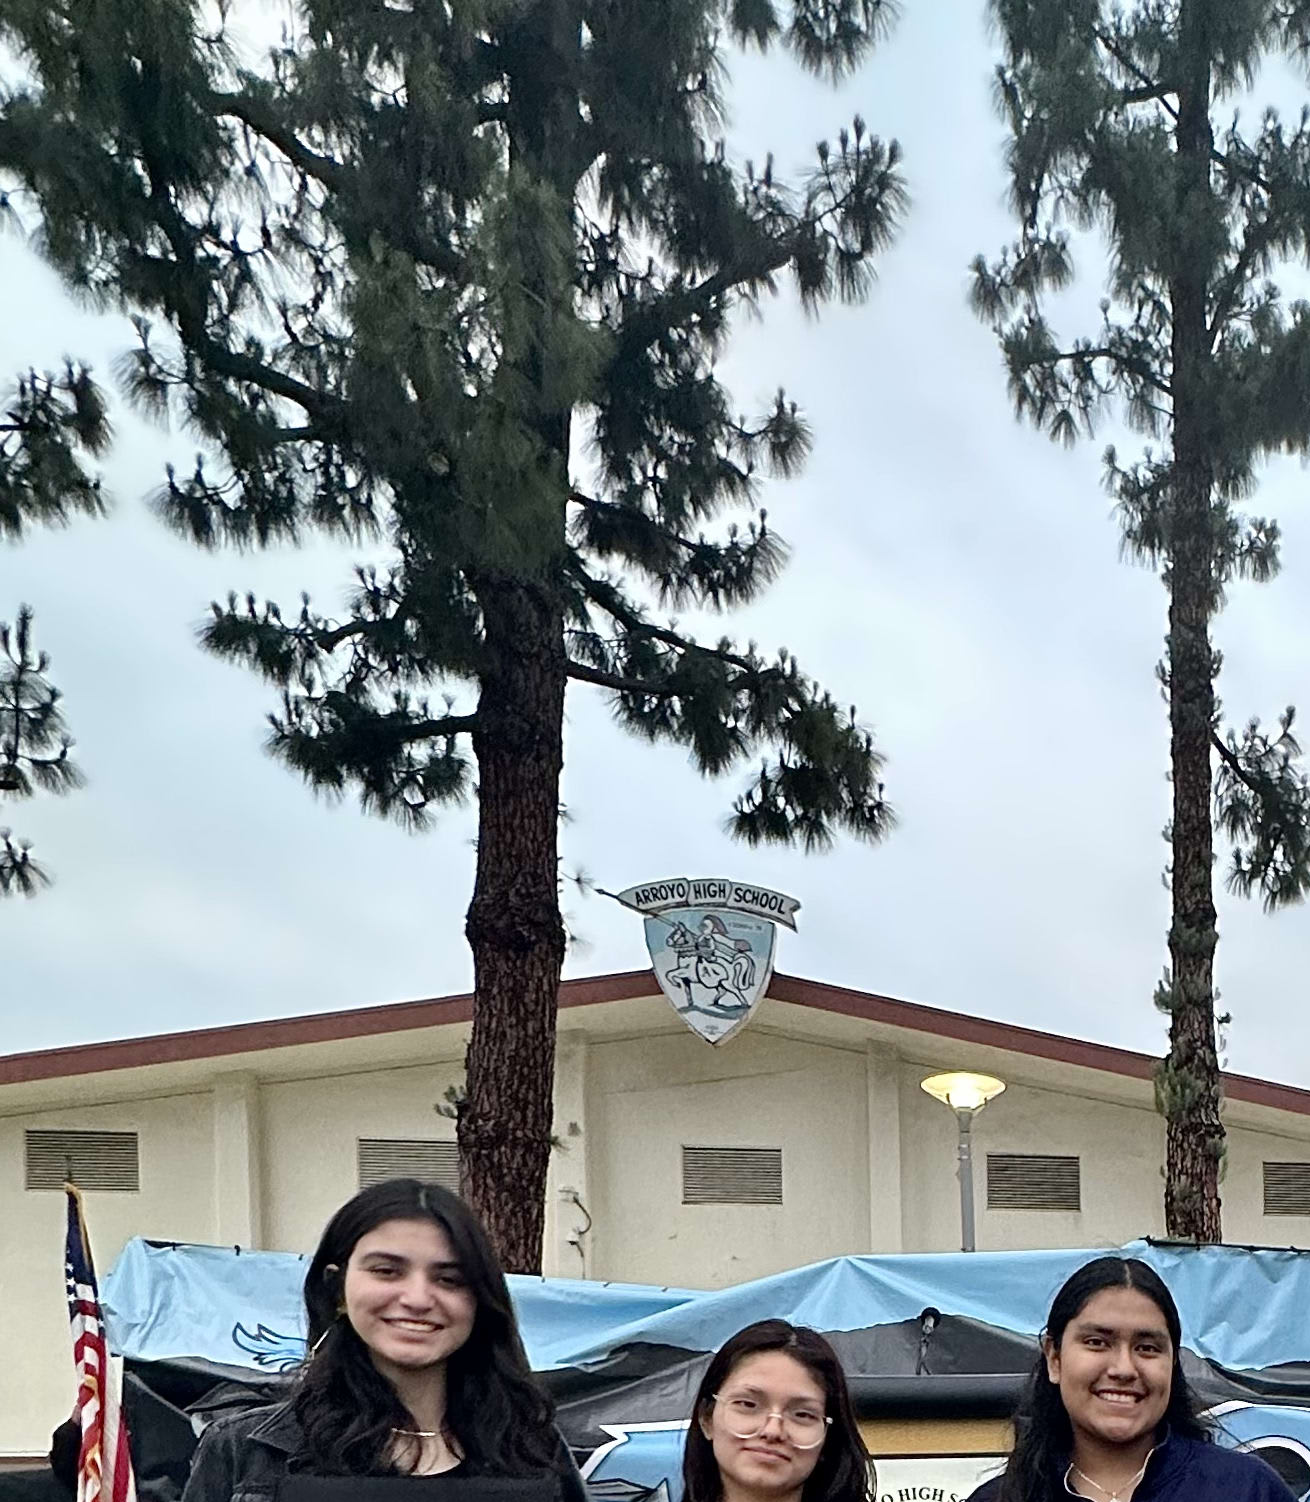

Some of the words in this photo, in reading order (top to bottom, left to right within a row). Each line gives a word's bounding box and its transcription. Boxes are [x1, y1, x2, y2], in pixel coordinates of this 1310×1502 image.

[634, 882, 686, 907] ARROYO
[693, 882, 726, 899] HIGH
[733, 886, 786, 914] SCHOOL
[898, 1487, 945, 1502] HIGH
